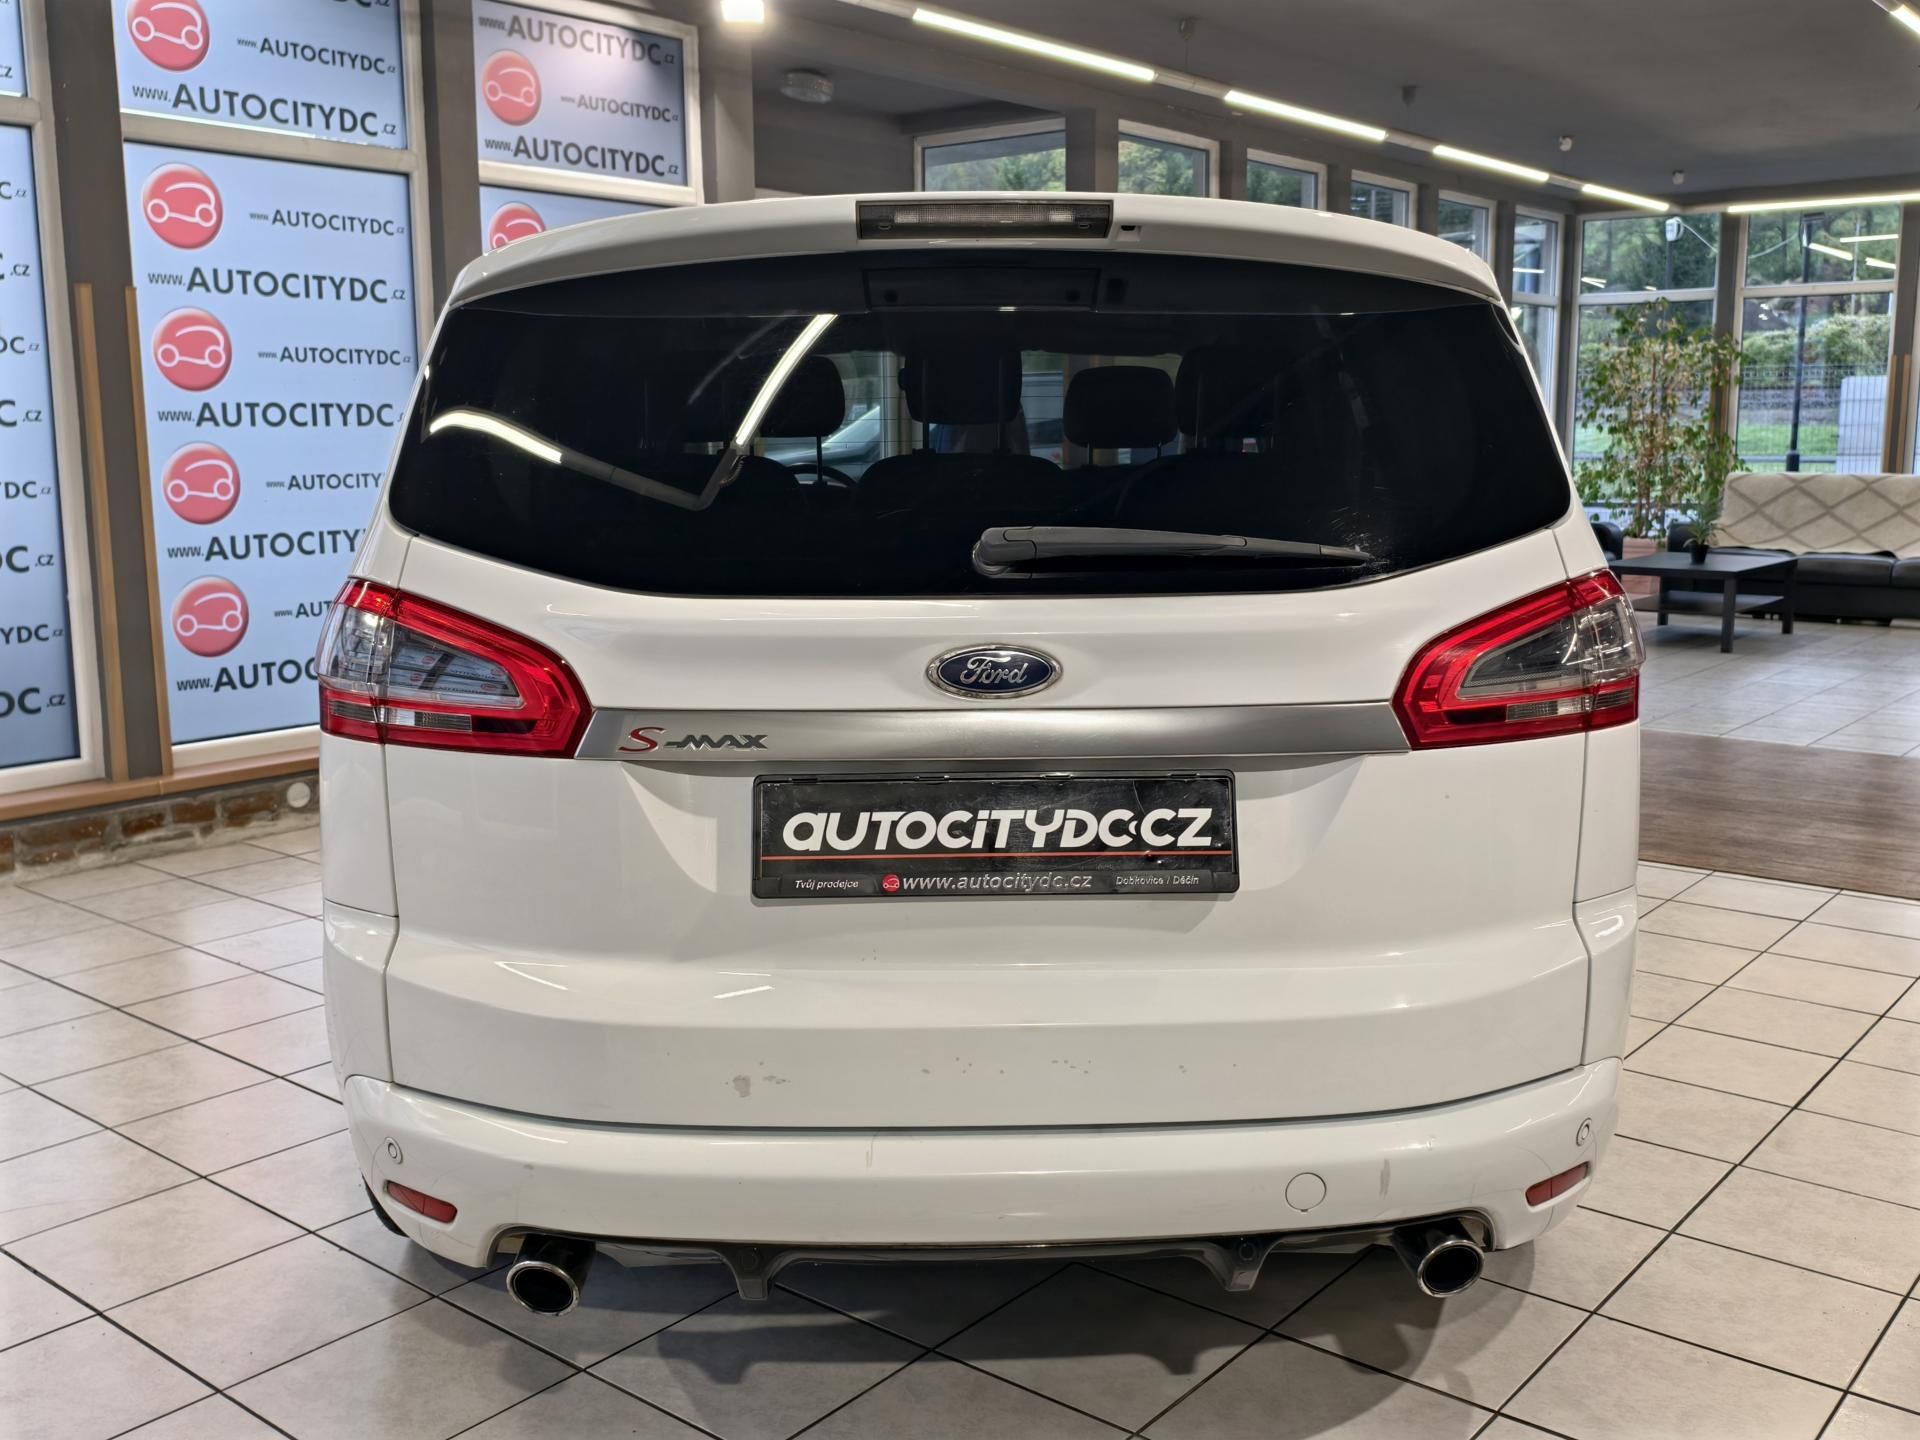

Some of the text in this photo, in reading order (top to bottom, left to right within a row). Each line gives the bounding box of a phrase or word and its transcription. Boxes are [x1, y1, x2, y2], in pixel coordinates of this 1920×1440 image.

[132, 83, 397, 137] www.AUTOCITYDC.cz
[485, 136, 679, 177] www.AUTOCITYDC.cz
[148, 267, 406, 303] www.AUTOCITYDC.cz
[266, 472, 385, 491] www.AUTOCITY
[167, 528, 366, 561] www.AUTOCITY
[959, 655, 1029, 685] Ford
[617, 726, 769, 752] S-MAX
[902, 872, 1093, 892] www.autocitydc.cz
